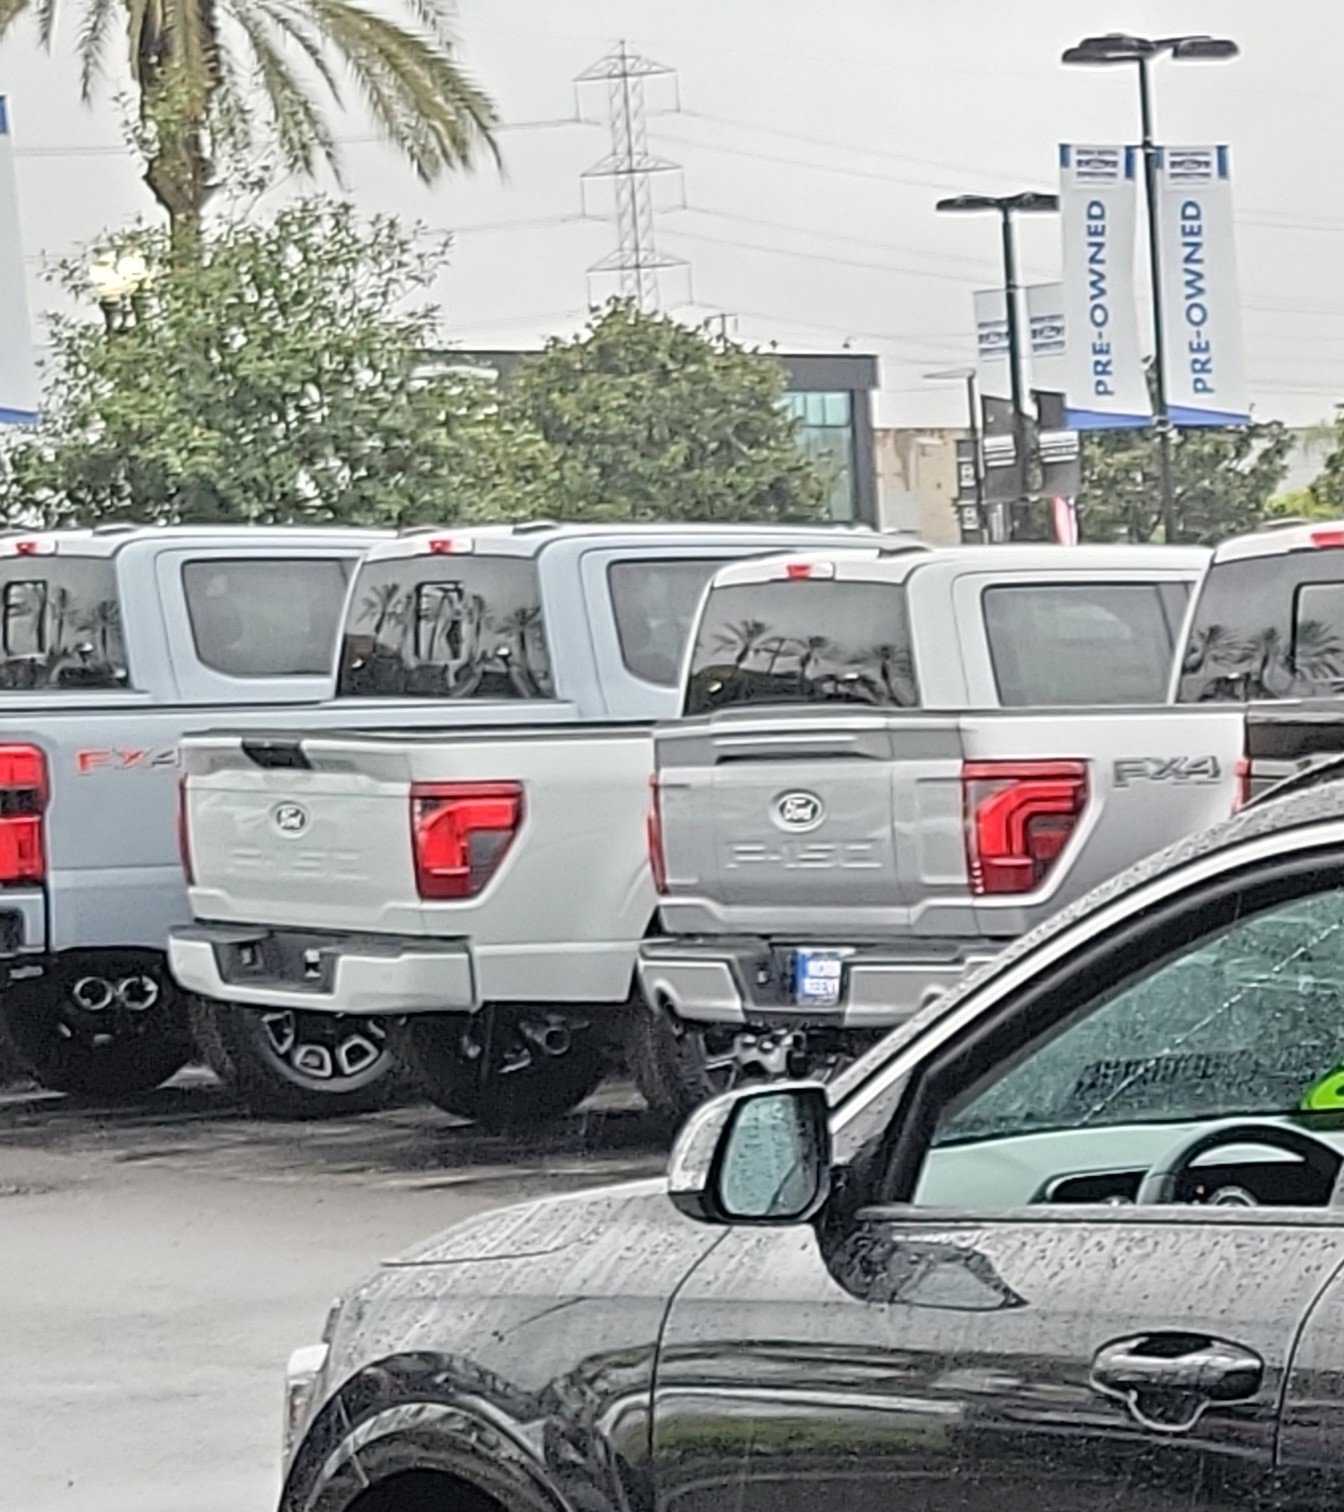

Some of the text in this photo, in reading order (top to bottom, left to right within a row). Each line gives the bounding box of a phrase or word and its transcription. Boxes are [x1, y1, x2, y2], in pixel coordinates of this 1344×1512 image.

[1086, 199, 1115, 396] PRE-OWNED
[1181, 199, 1215, 395] PRE-OWNED
[75, 747, 183, 776] FX4
[1112, 755, 1222, 788] FX4
